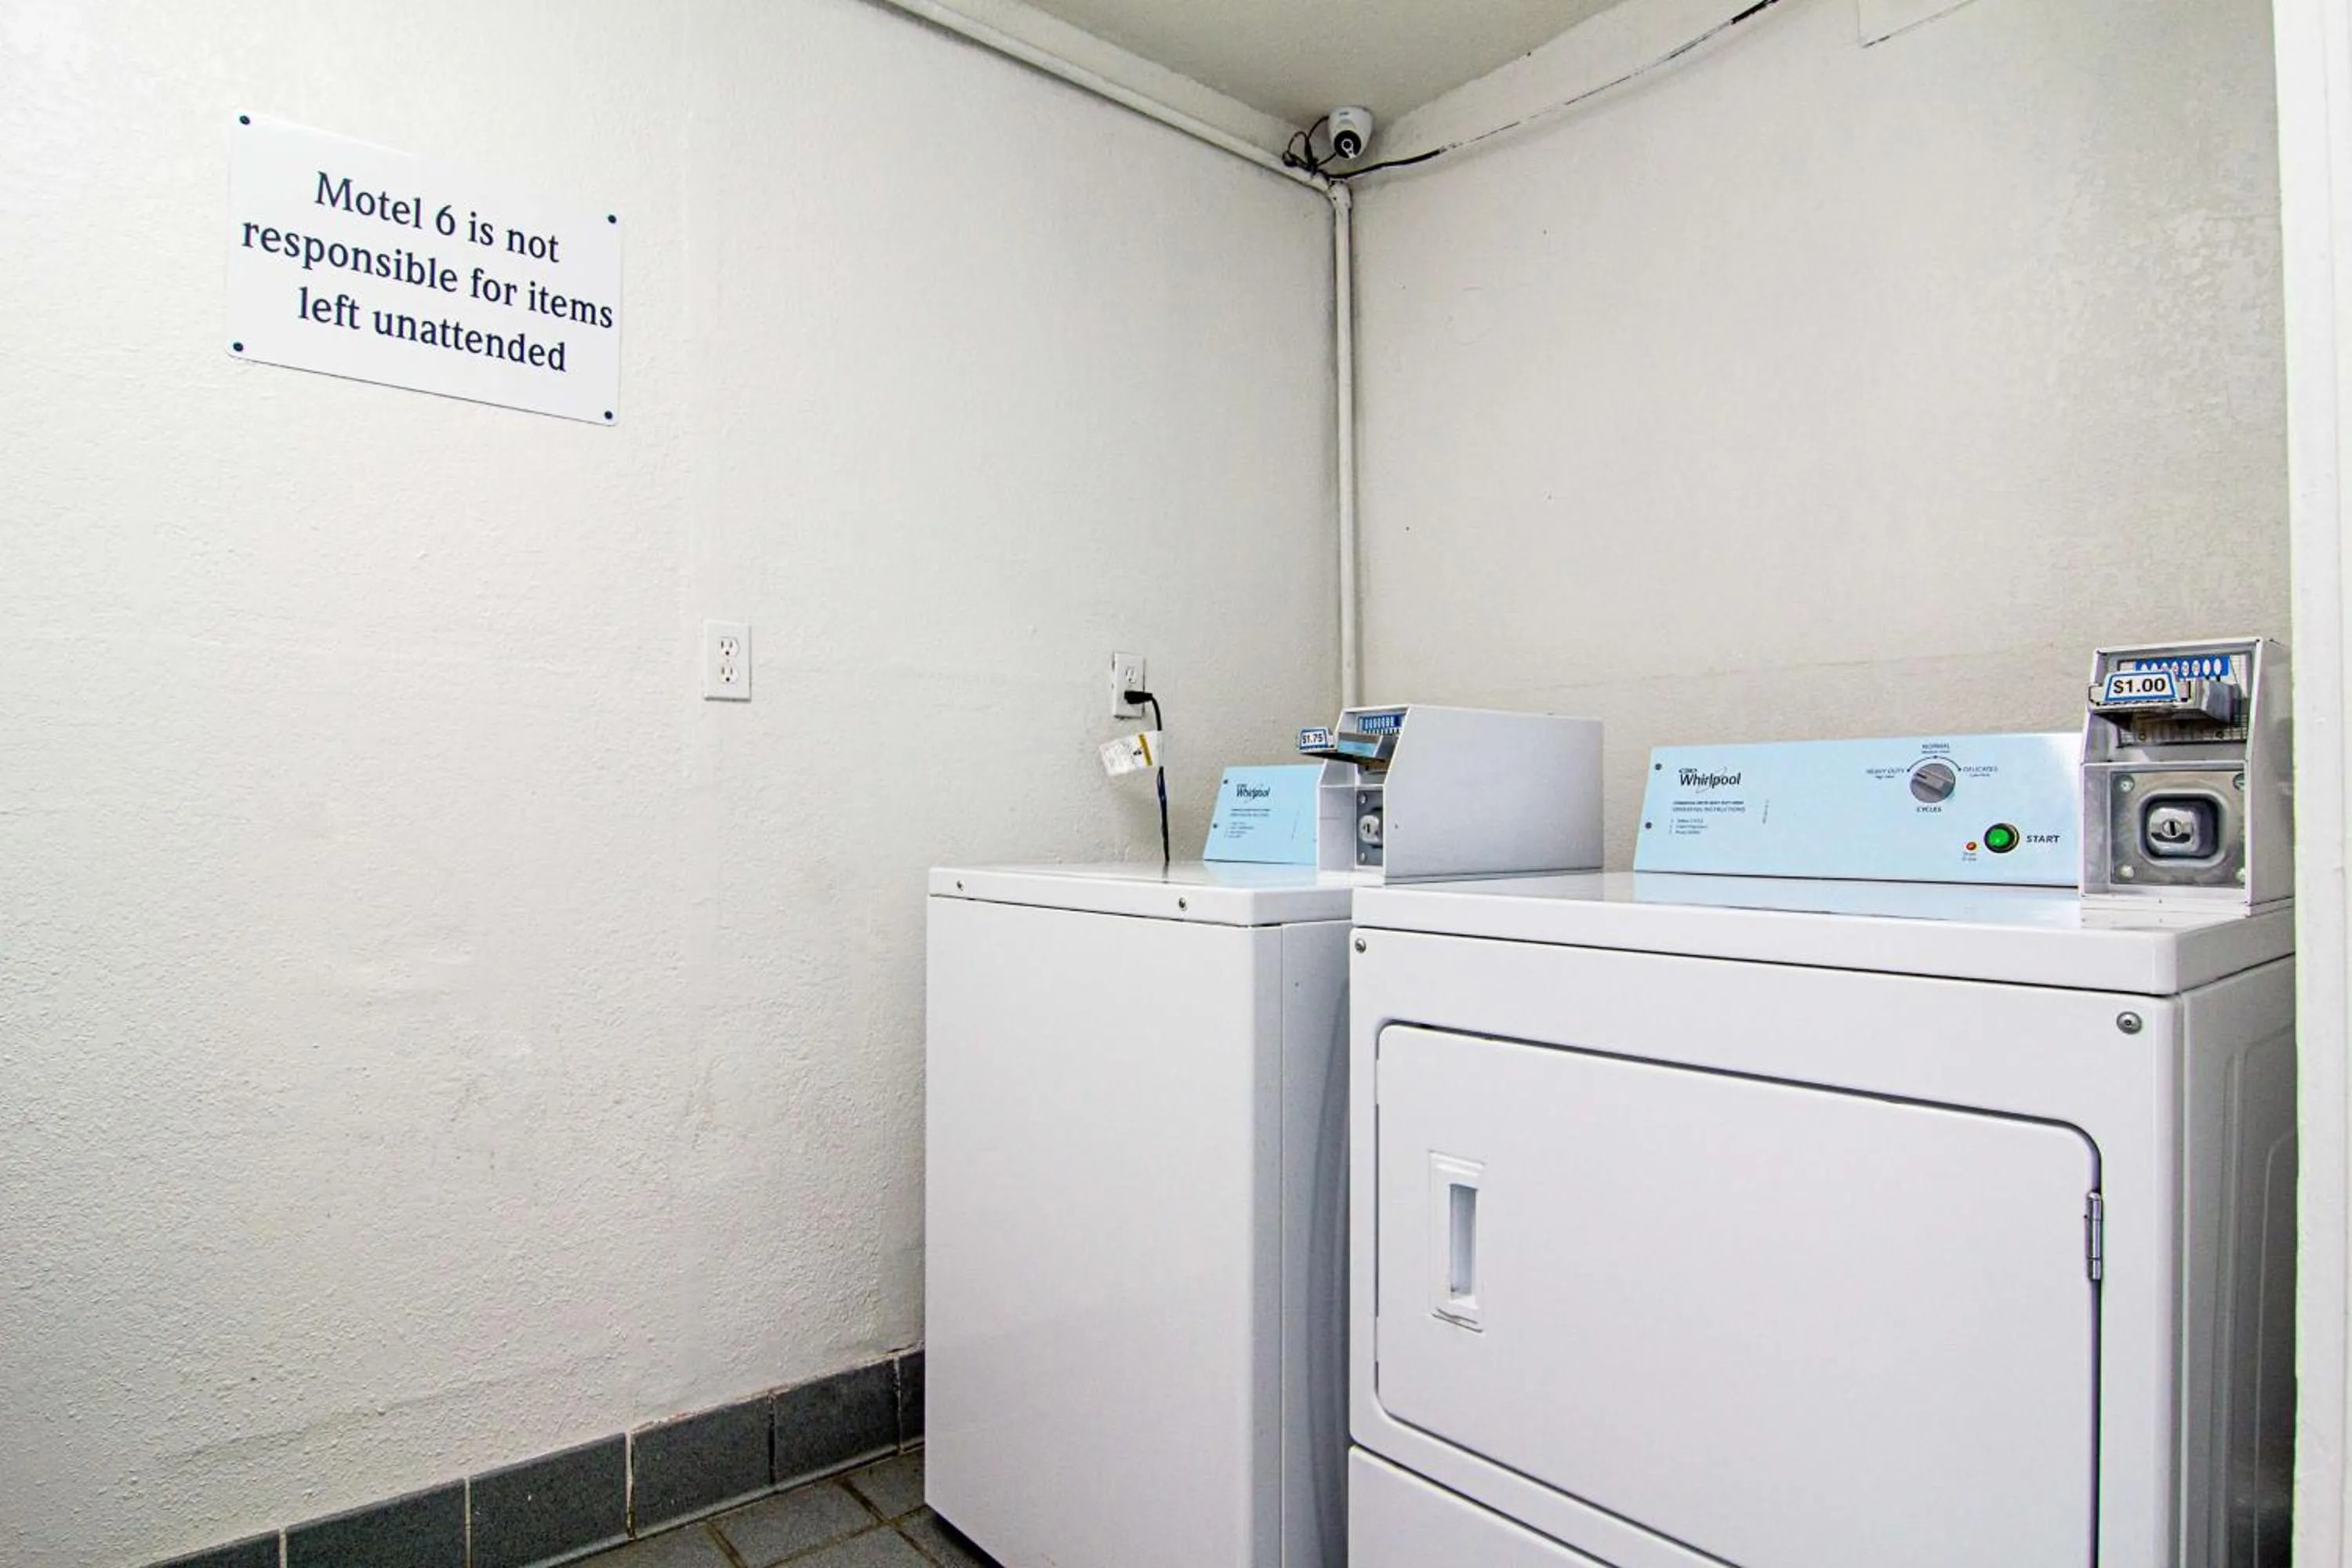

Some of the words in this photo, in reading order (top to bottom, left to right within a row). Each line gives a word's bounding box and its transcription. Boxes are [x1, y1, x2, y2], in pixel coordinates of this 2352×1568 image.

[315, 171, 422, 230] Motel
[435, 205, 456, 236] 6
[469, 211, 494, 246] is
[506, 229, 559, 263] not
[242, 222, 458, 292] responsible
[470, 267, 517, 307] for
[528, 280, 613, 328] items
[299, 286, 361, 330] left
[372, 310, 566, 372] unattended
[2113, 677, 2166, 694] $1.00
[1302, 733, 1323, 744] $1.75
[1680, 772, 1741, 789] Whirlpool
[1236, 786, 1271, 800] Whirlpool
